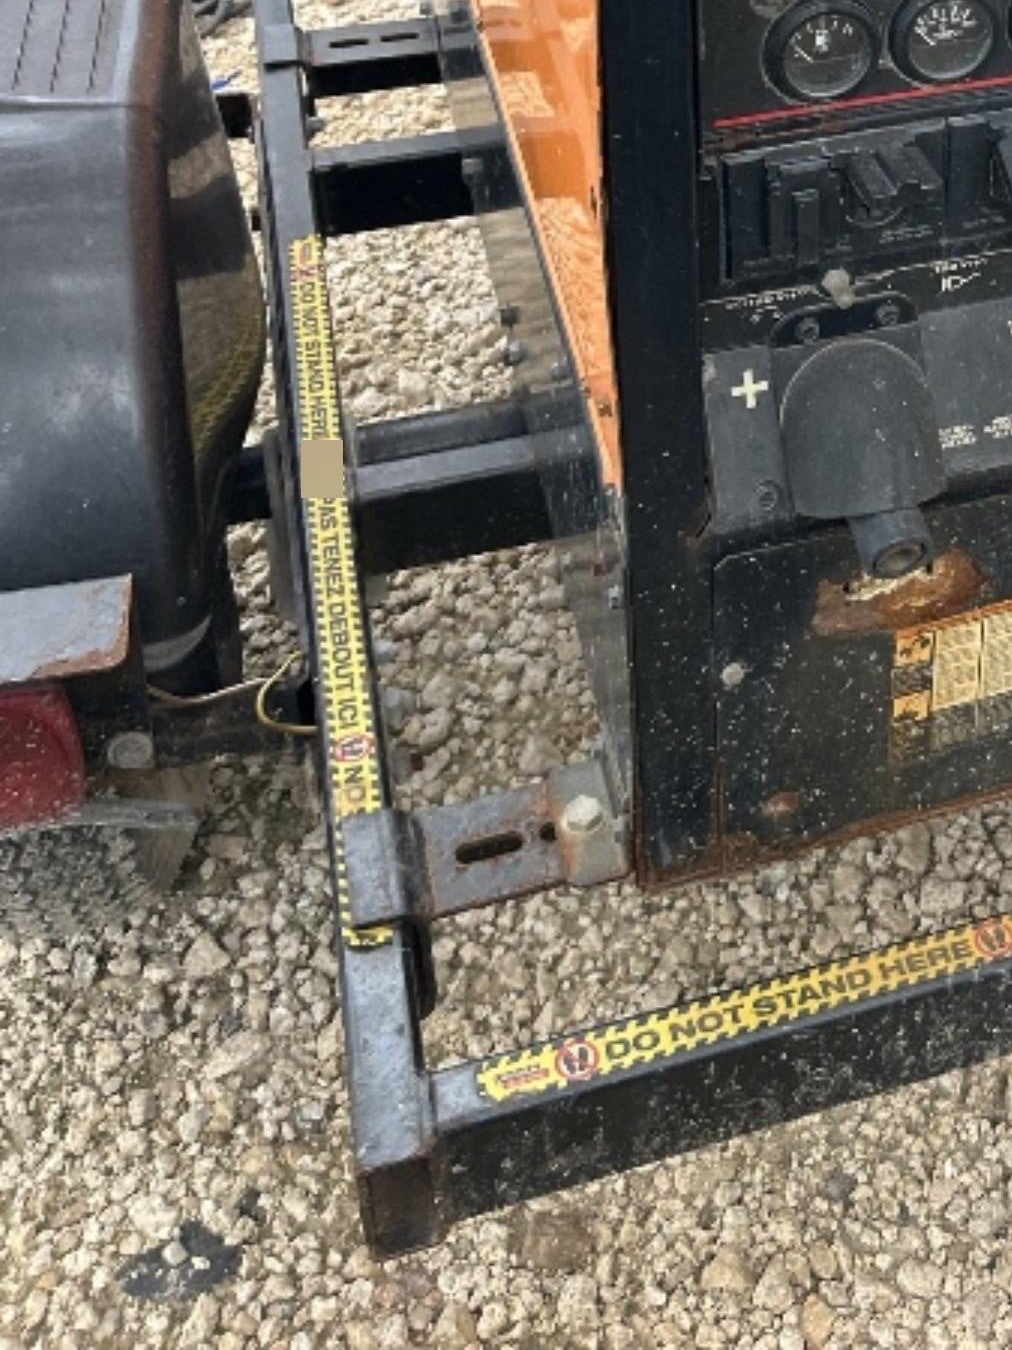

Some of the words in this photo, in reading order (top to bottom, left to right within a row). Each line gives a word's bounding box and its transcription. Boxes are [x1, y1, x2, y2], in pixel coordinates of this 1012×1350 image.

[322, 533, 345, 598] TENEZ
[328, 601, 355, 692] DEBOUT
[338, 697, 359, 730] ICI
[604, 1023, 661, 1061] DO
[671, 1002, 746, 1042] NOT
[752, 967, 871, 1017] STAND
[881, 938, 971, 980] HERE
